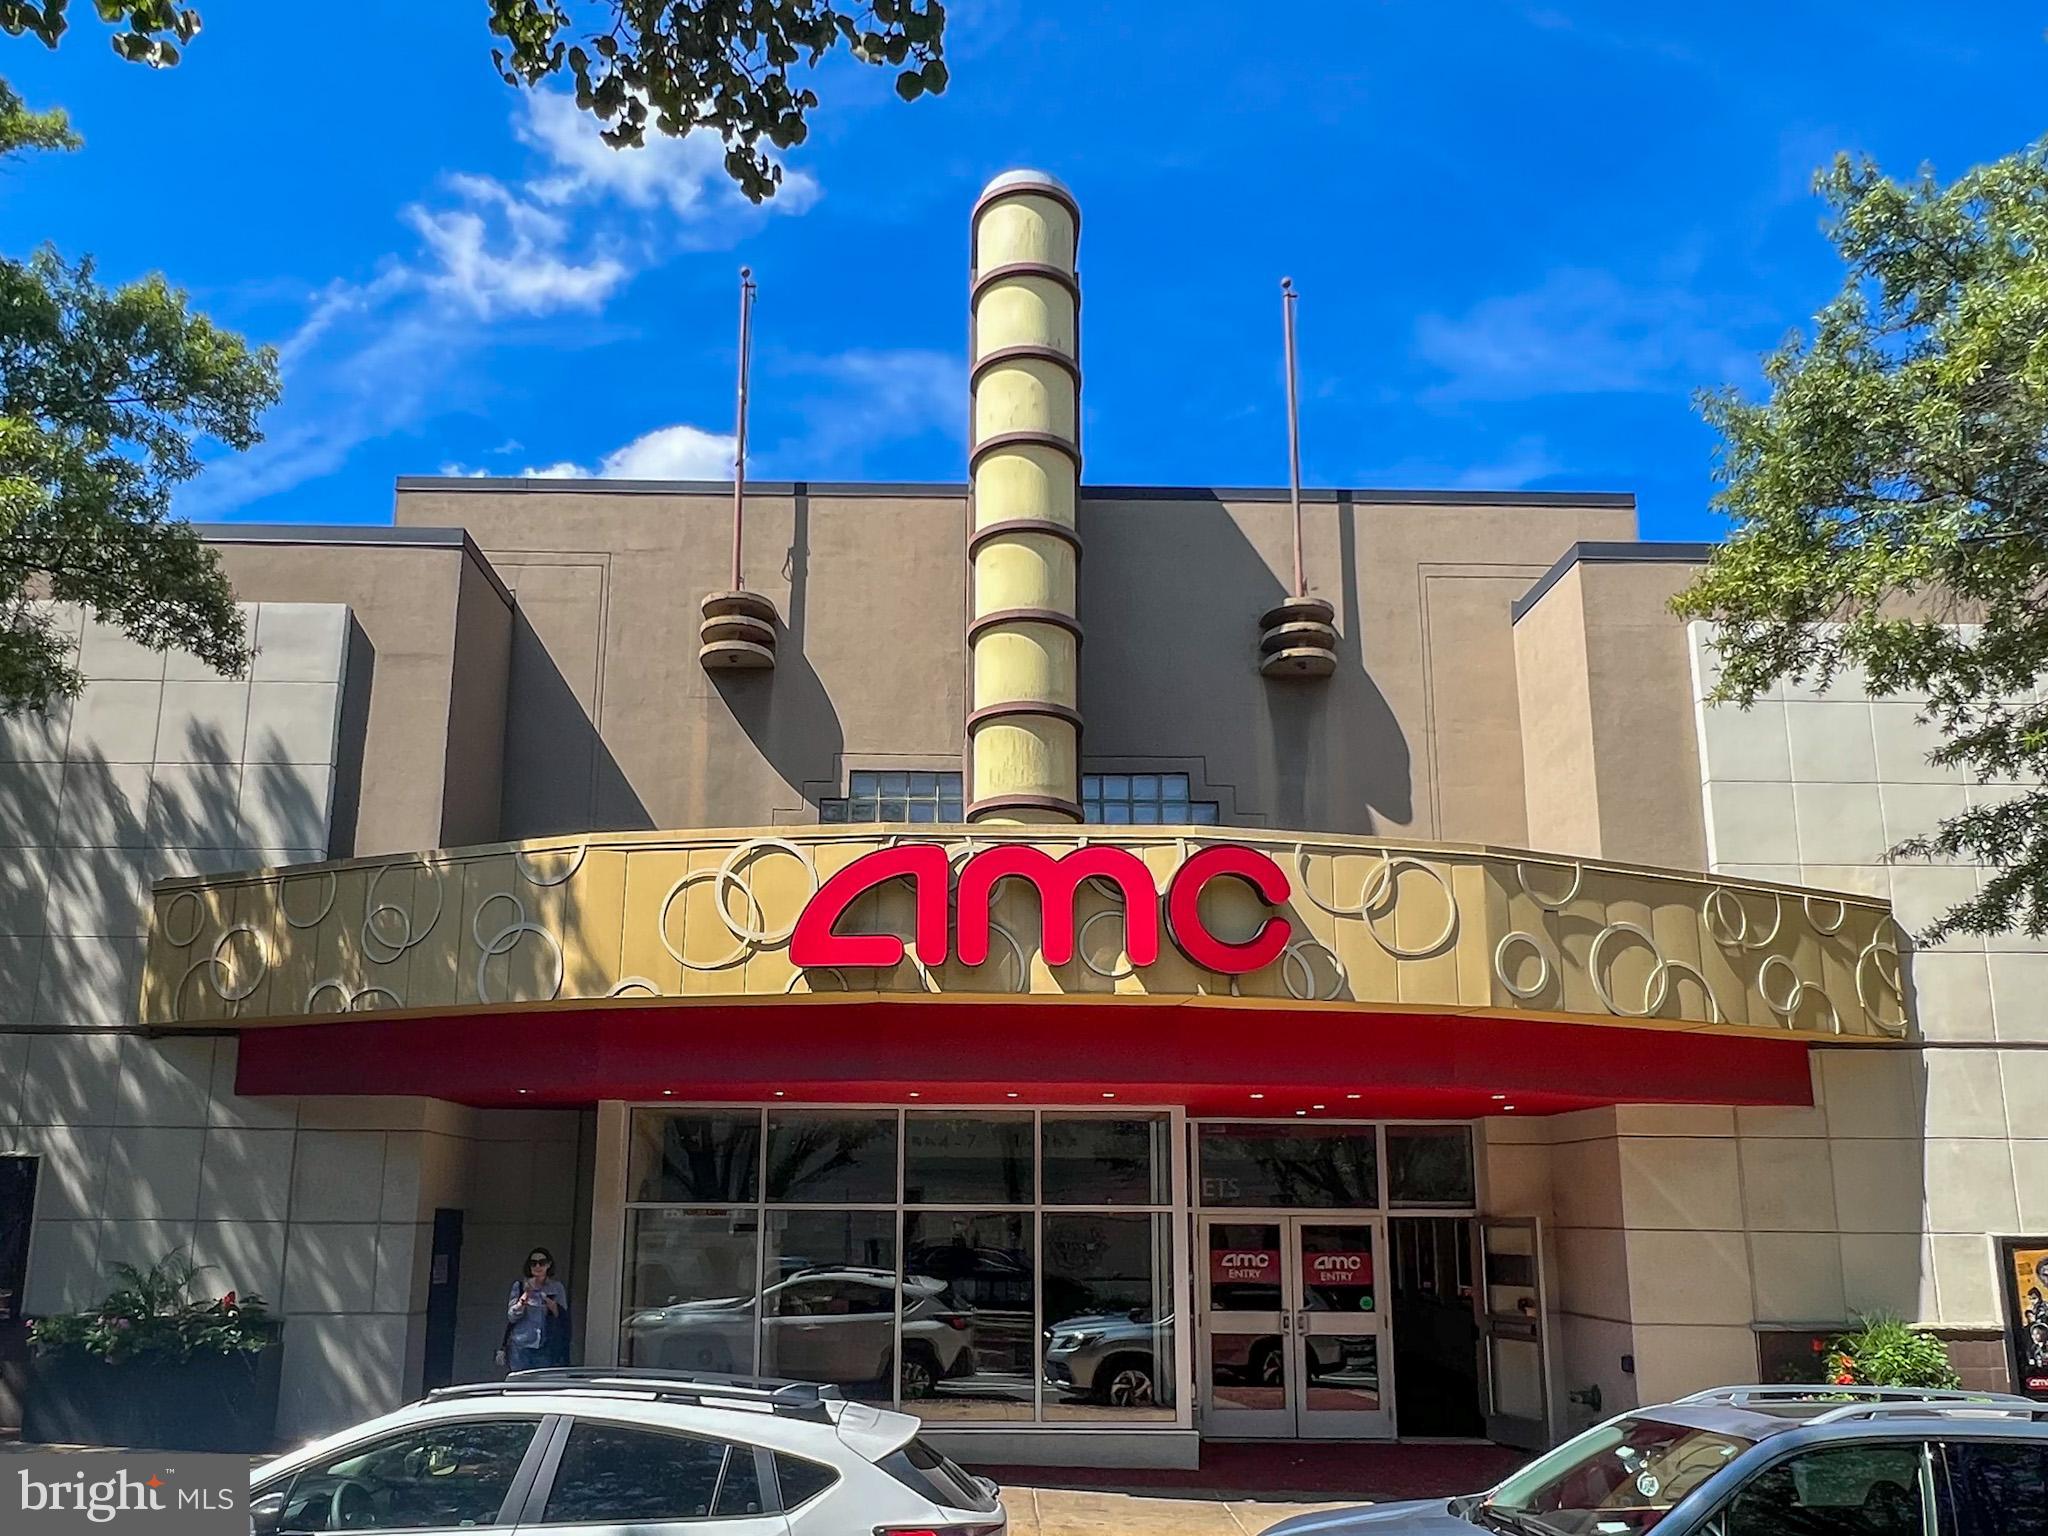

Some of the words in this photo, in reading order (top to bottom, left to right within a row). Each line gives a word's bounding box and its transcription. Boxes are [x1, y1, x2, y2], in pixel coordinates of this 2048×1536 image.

[789, 844, 1292, 975] amc
[1221, 1253, 1270, 1267] amc
[1313, 1255, 1361, 1270] amc
[1228, 1269, 1262, 1280] ENTRY
[1320, 1271, 1353, 1282] ENTRY
